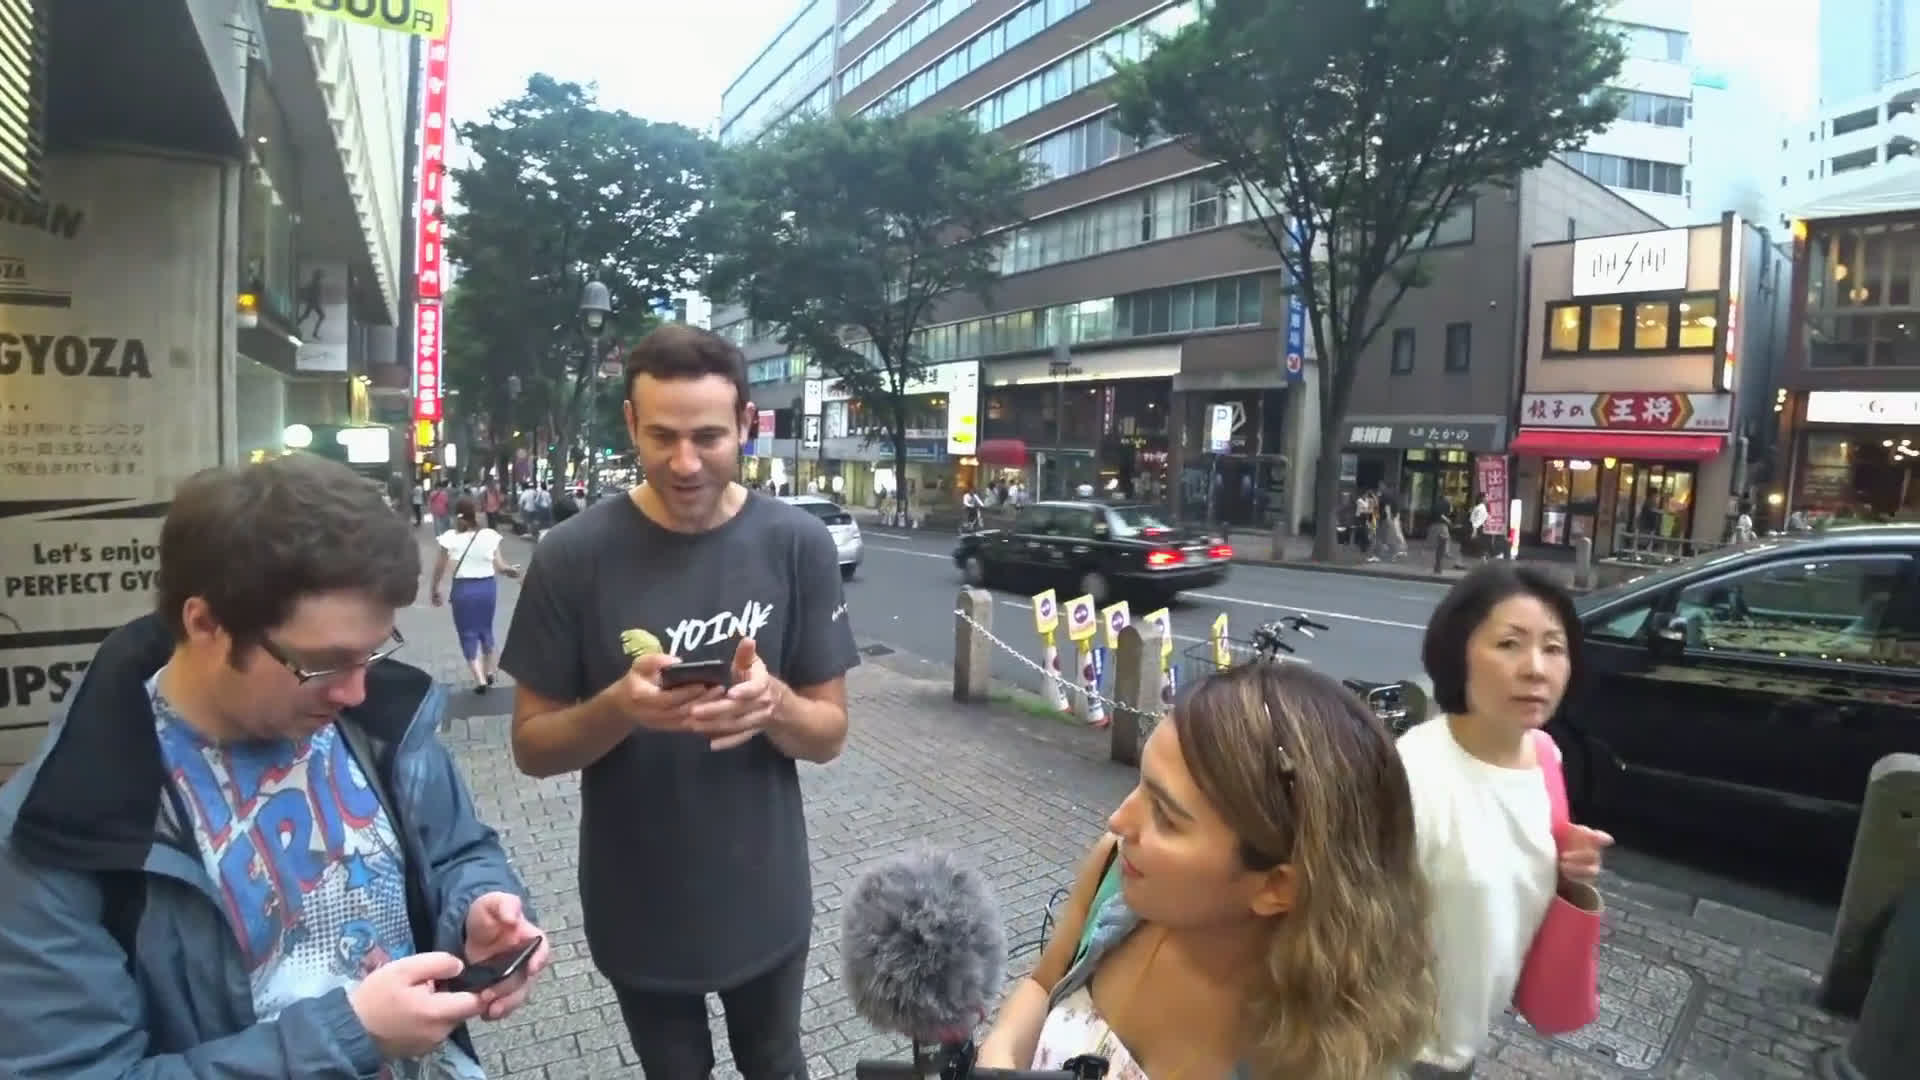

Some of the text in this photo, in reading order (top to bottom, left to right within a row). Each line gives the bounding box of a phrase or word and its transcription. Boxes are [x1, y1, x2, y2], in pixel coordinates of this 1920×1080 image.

[0, 332, 153, 378] GYOZA
[1528, 396, 1674, 423] 餃子の 王将
[1428, 427, 1470, 440] たかの
[34, 543, 92, 565] Let's
[6, 572, 111, 598] PERFECT
[665, 600, 774, 657] YOINK
